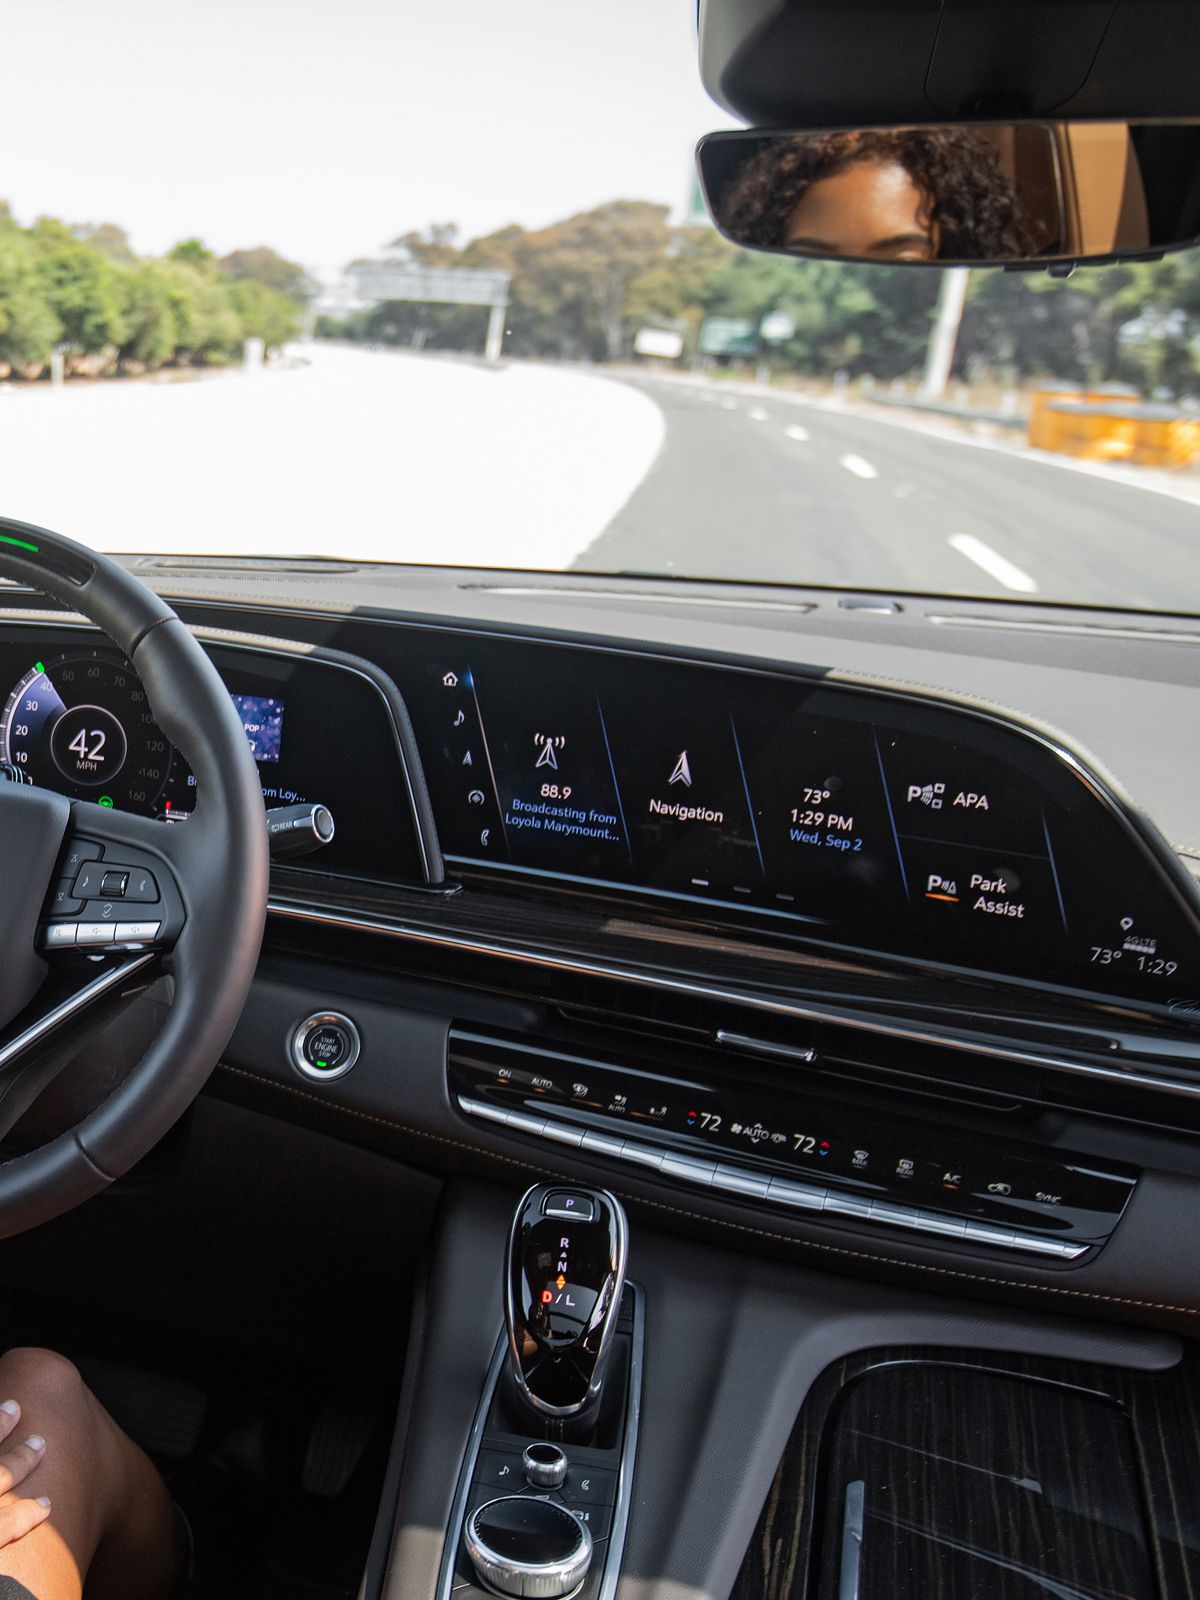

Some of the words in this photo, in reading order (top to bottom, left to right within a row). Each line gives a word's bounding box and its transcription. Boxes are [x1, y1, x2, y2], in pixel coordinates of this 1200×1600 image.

[62, 671, 75, 682] 50
[87, 667, 100, 678] 60
[40, 681, 52, 692] 40
[114, 676, 126, 687] 70
[131, 691, 144, 702] 80
[26, 700, 38, 712] 30
[15, 725, 28, 736] 20
[68, 728, 106, 761] 42
[146, 740, 164, 752] 120
[16, 752, 28, 763] 10
[76, 760, 98, 772] MPH
[142, 768, 160, 780] 140
[128, 790, 146, 802] 160
[280, 788, 306, 803] Loy...
[540, 784, 572, 800] 88.9
[803, 788, 831, 805] 73°
[952, 792, 990, 811] APA
[512, 798, 586, 822] Broadcasting
[589, 810, 617, 825] from
[649, 798, 724, 822] Navigation
[790, 808, 824, 826] 1:29
[827, 815, 854, 832] PM
[505, 814, 542, 830] Loyola
[544, 820, 620, 842] Marymount...
[790, 828, 822, 847] Wed,
[826, 834, 852, 852] Sep
[853, 838, 864, 852] 2
[970, 874, 1008, 894] Park
[973, 896, 1026, 919] Assist
[1090, 946, 1122, 964] 73°
[1138, 956, 1178, 976] 1:29
[314, 1041, 338, 1054] ENGINE
[498, 1068, 512, 1078] ON
[532, 1077, 552, 1088] AUTO
[608, 1104, 626, 1114] AUTO
[700, 1112, 722, 1132] 72
[743, 1126, 770, 1140] AUTO
[793, 1134, 816, 1154] 72
[566, 1199, 574, 1208] P
[560, 1237, 570, 1248] R
[557, 1261, 568, 1273] N
